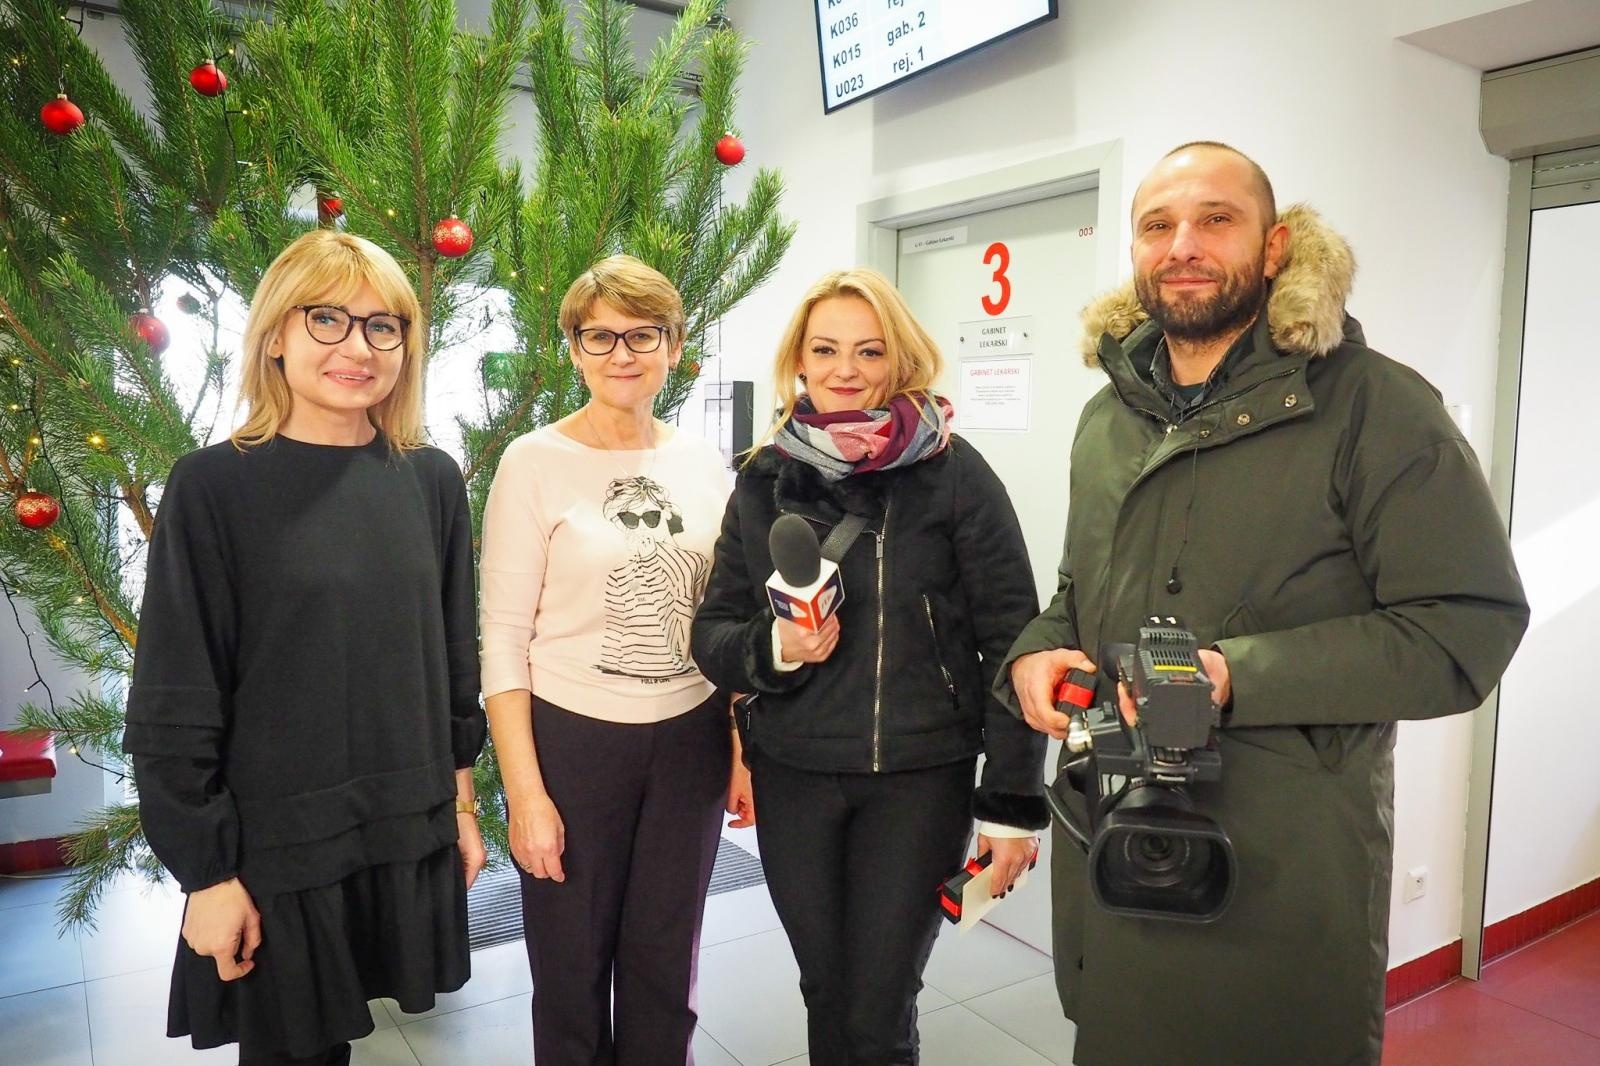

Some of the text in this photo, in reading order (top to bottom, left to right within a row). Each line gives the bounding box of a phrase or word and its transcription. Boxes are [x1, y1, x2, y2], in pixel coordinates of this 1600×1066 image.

[830, 12, 859, 39] K036
[887, 11, 926, 46] gab. 2
[833, 44, 861, 69] K015
[893, 46, 925, 73] rej. 1
[835, 74, 864, 97] U023
[1078, 226, 1094, 237] 003
[981, 242, 1011, 316] 3
[981, 327, 1006, 335] GABINET
[979, 339, 1007, 348] LEKARSKI
[969, 367, 1020, 377] GABINET LEKARSKI
